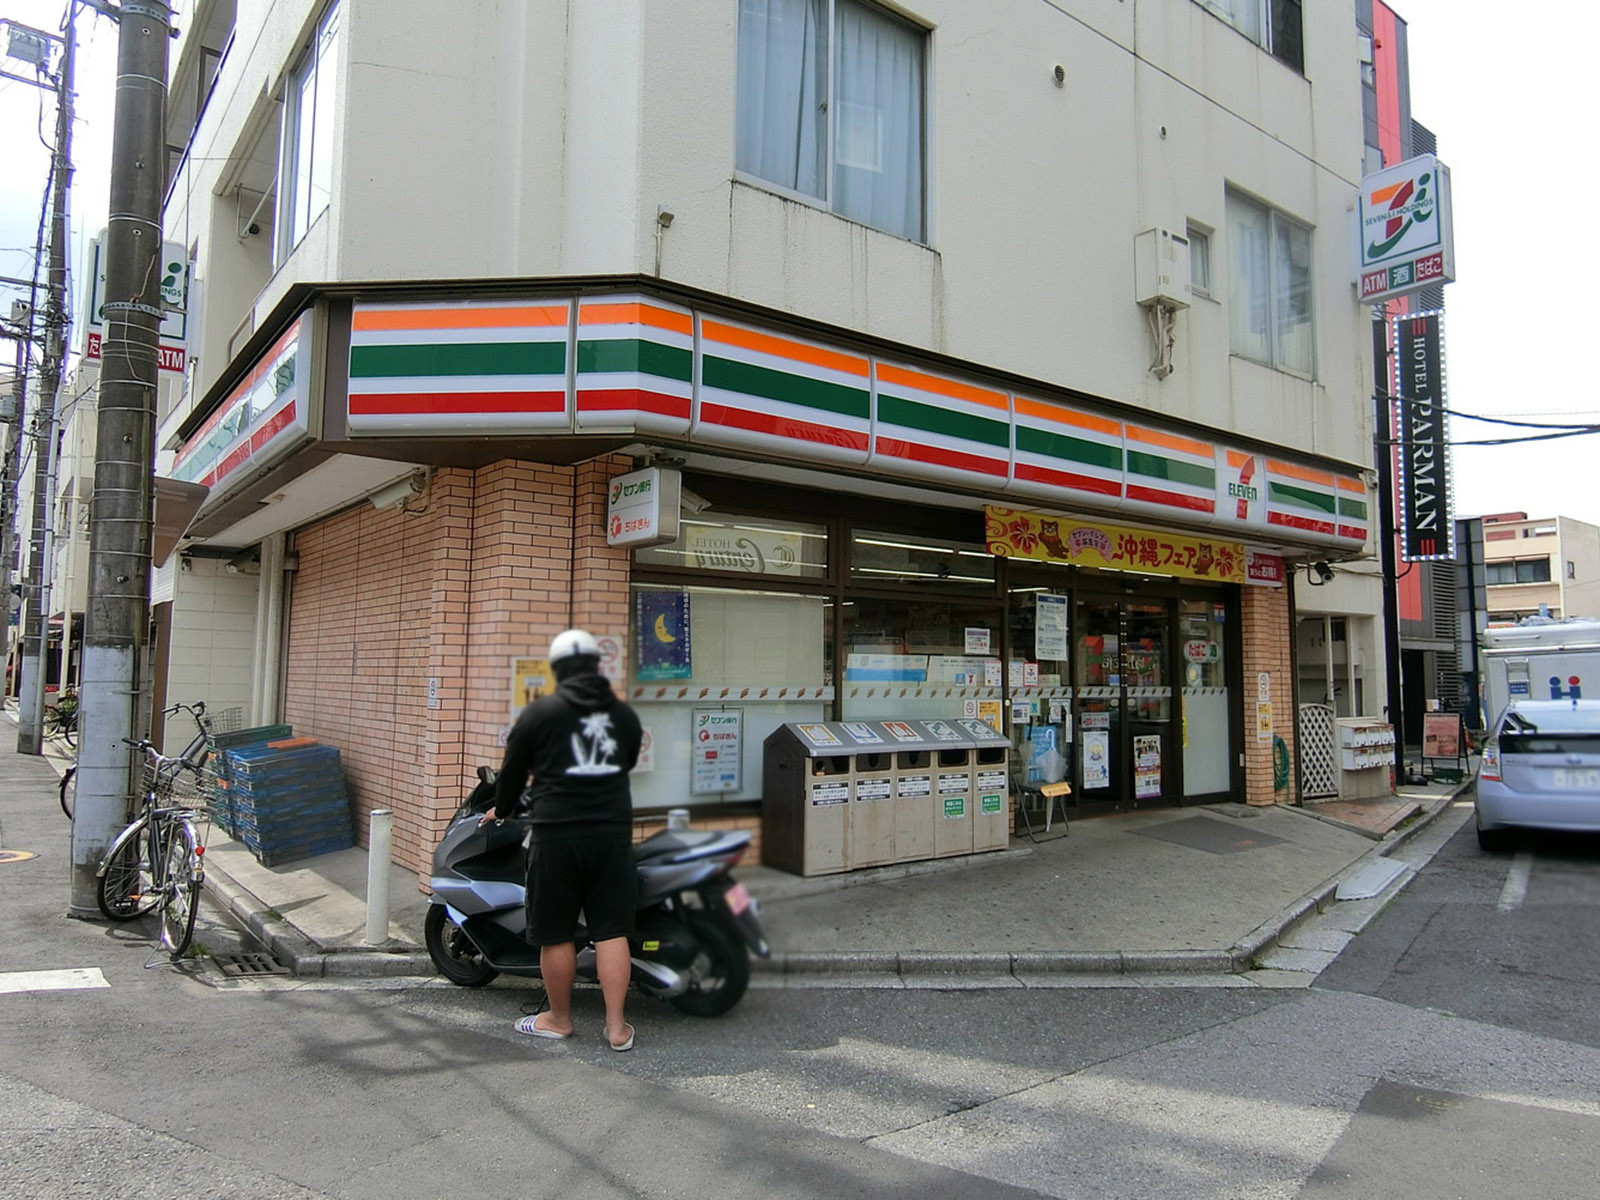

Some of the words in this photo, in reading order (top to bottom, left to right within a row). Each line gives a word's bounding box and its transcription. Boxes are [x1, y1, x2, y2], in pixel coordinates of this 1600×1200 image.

[1363, 272, 1387, 294] ATM
[1392, 265, 1410, 286] 酒
[1416, 257, 1442, 278] たばこ
[159, 349, 183, 368] ATM
[1413, 337, 1428, 393] HOTEL
[1412, 396, 1438, 532] PARMAN
[623, 480, 652, 497] セブン銀行
[624, 518, 650, 533] ちばぎん
[1113, 533, 1197, 569] 沖縄フェア
